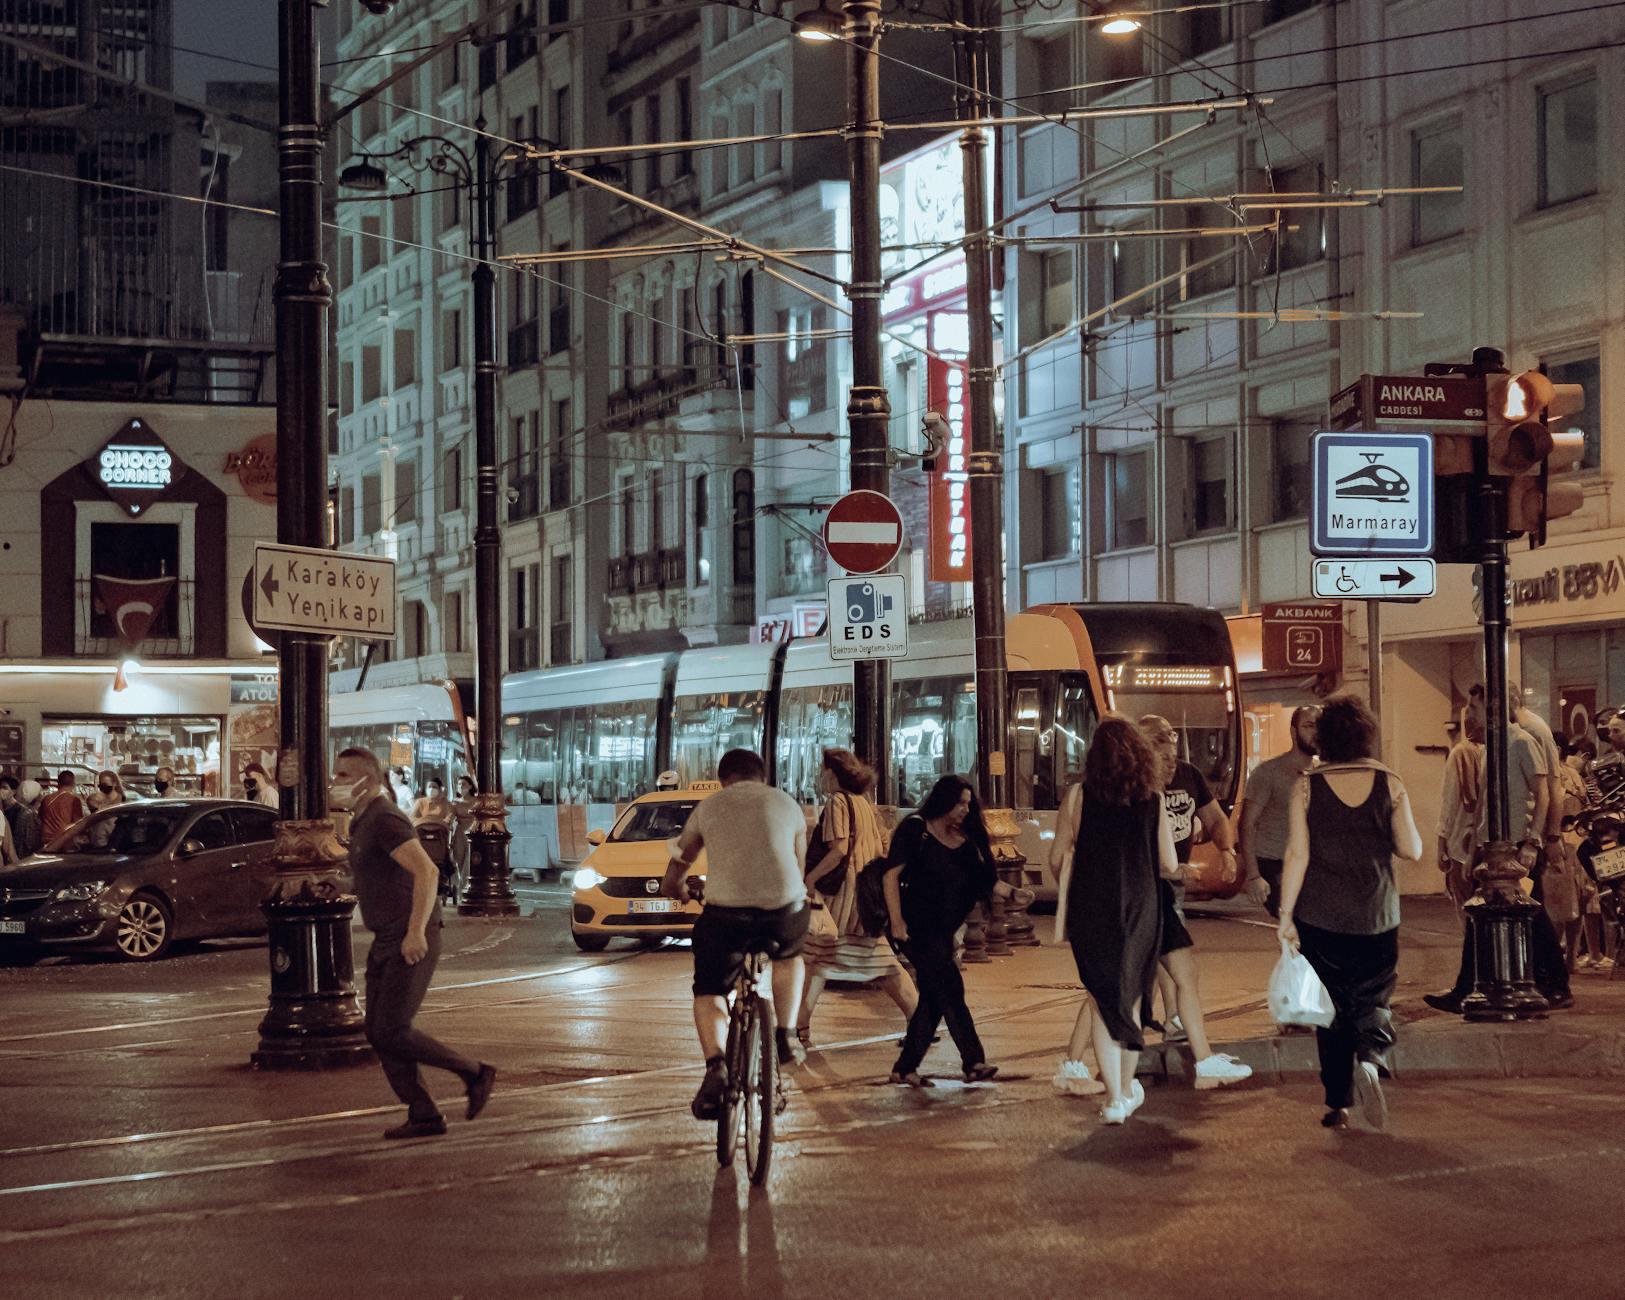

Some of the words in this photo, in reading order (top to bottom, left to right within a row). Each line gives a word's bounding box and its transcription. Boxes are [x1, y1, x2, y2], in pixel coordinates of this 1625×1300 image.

[1380, 385, 1446, 402] ANKARA
[1380, 403, 1423, 416] CADDESİ
[100, 450, 172, 469] CHOCO
[100, 468, 172, 484] CORNER
[1331, 513, 1418, 534] Marmaray
[287, 559, 381, 596] Karaköy
[287, 591, 386, 628] Yenikapı
[1275, 607, 1334, 619] AKBANK
[844, 624, 891, 641] EDS
[1296, 649, 1312, 661] 24
